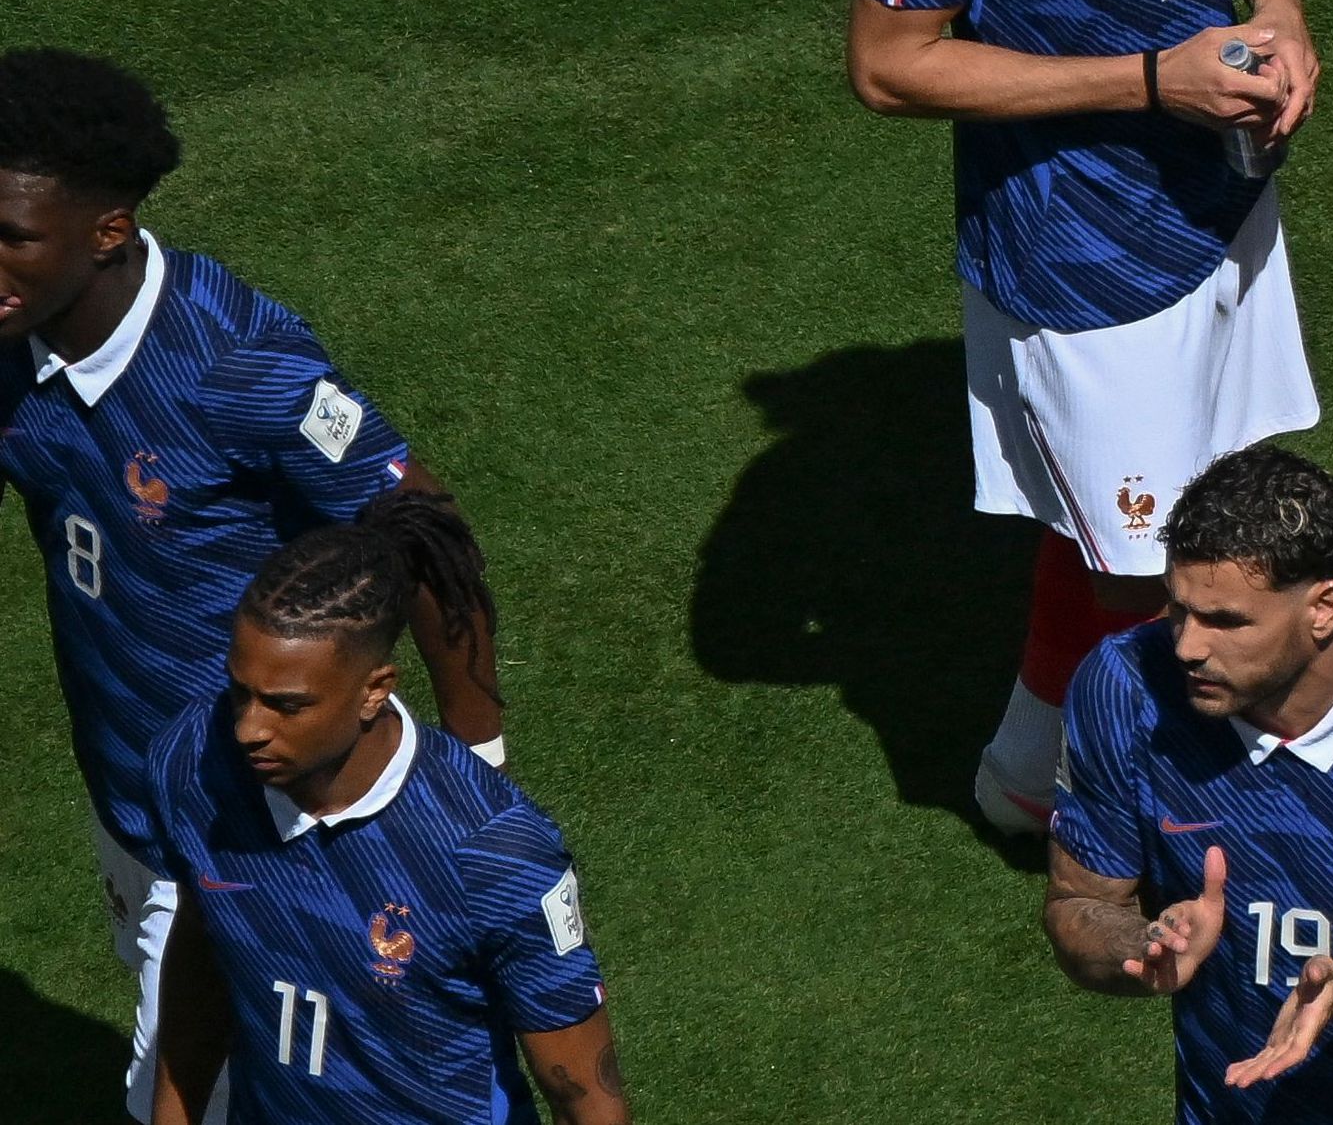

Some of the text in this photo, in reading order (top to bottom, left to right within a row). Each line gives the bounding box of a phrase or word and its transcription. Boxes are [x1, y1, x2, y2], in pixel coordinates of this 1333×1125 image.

[65, 515, 101, 599] 8
[1248, 901, 1330, 987] 19
[273, 980, 328, 1077] 11
